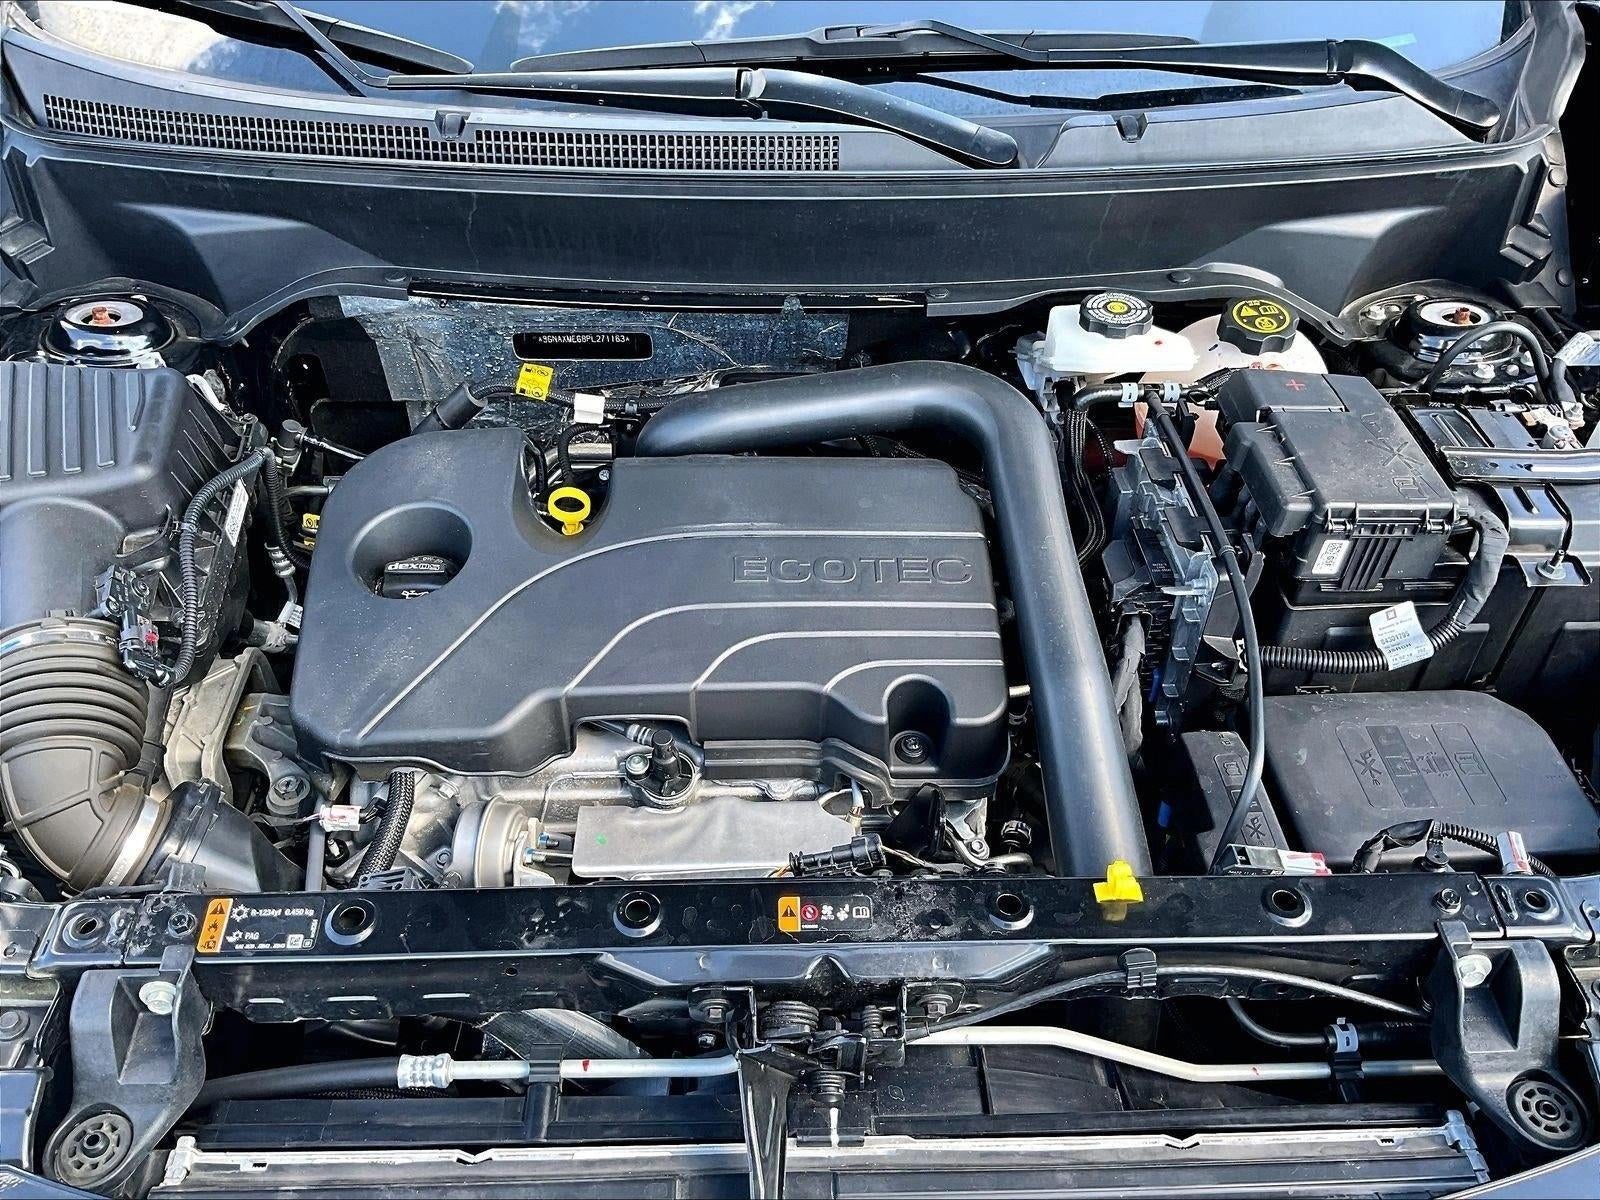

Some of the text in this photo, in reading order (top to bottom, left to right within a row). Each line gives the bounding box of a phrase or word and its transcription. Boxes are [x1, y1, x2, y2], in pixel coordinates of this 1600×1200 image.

[387, 562, 441, 571] dexos
[732, 555, 973, 584] ECOTEC
[304, 908, 315, 916] kg
[244, 931, 260, 940] PAG
